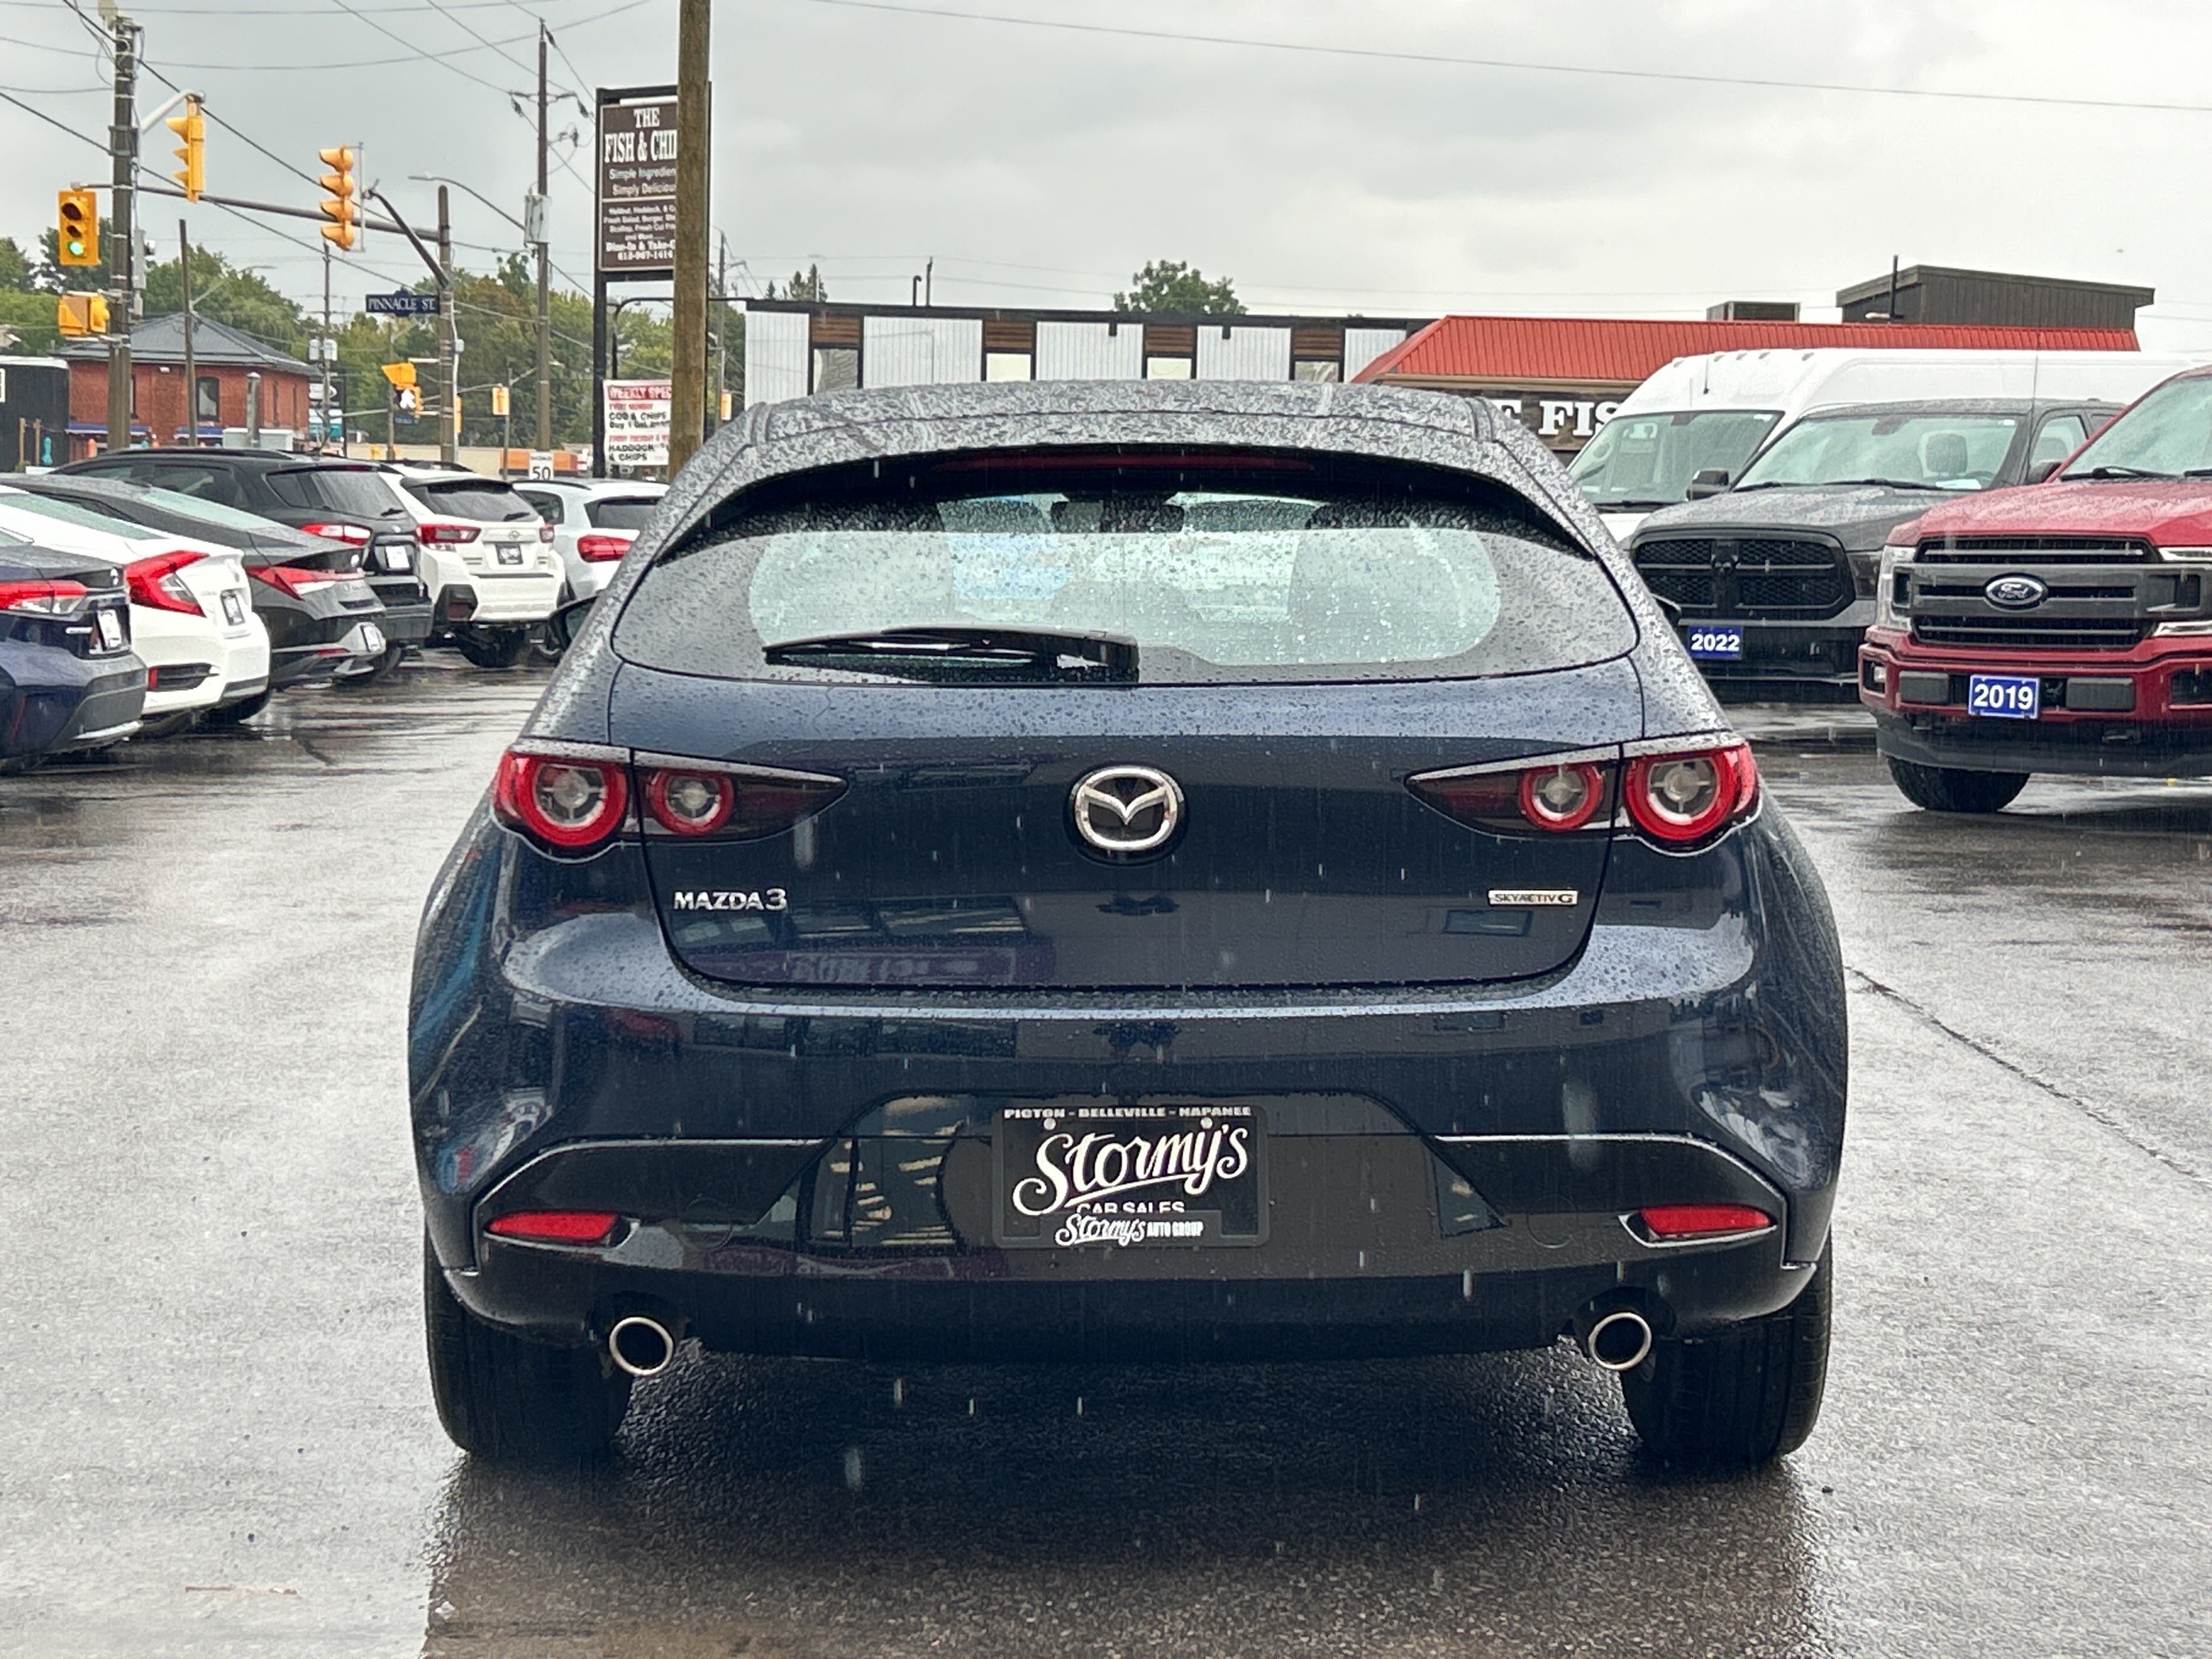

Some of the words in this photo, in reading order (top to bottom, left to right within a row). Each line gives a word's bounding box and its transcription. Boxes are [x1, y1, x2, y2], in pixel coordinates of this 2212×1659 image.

[634, 107, 660, 128] THE
[604, 131, 635, 163] FISH
[637, 131, 647, 162] &
[609, 167, 637, 181] Simple
[369, 297, 417, 311] PINNACLE
[532, 465, 551, 481] 50
[1691, 634, 1740, 651] 2022
[1973, 684, 2033, 710] 2019
[673, 888, 787, 911] MAZDA3
[1004, 1108, 1065, 1119] PICTON
[1078, 1108, 1166, 1118] BELLEVILLE
[1179, 1106, 1251, 1117] NAPANEE
[1012, 1124, 1248, 1216] Stormy's
[1055, 1213, 1145, 1247] Stormy's
[1147, 1221, 1171, 1237] AUTO
[1172, 1220, 1204, 1237] GROUP
